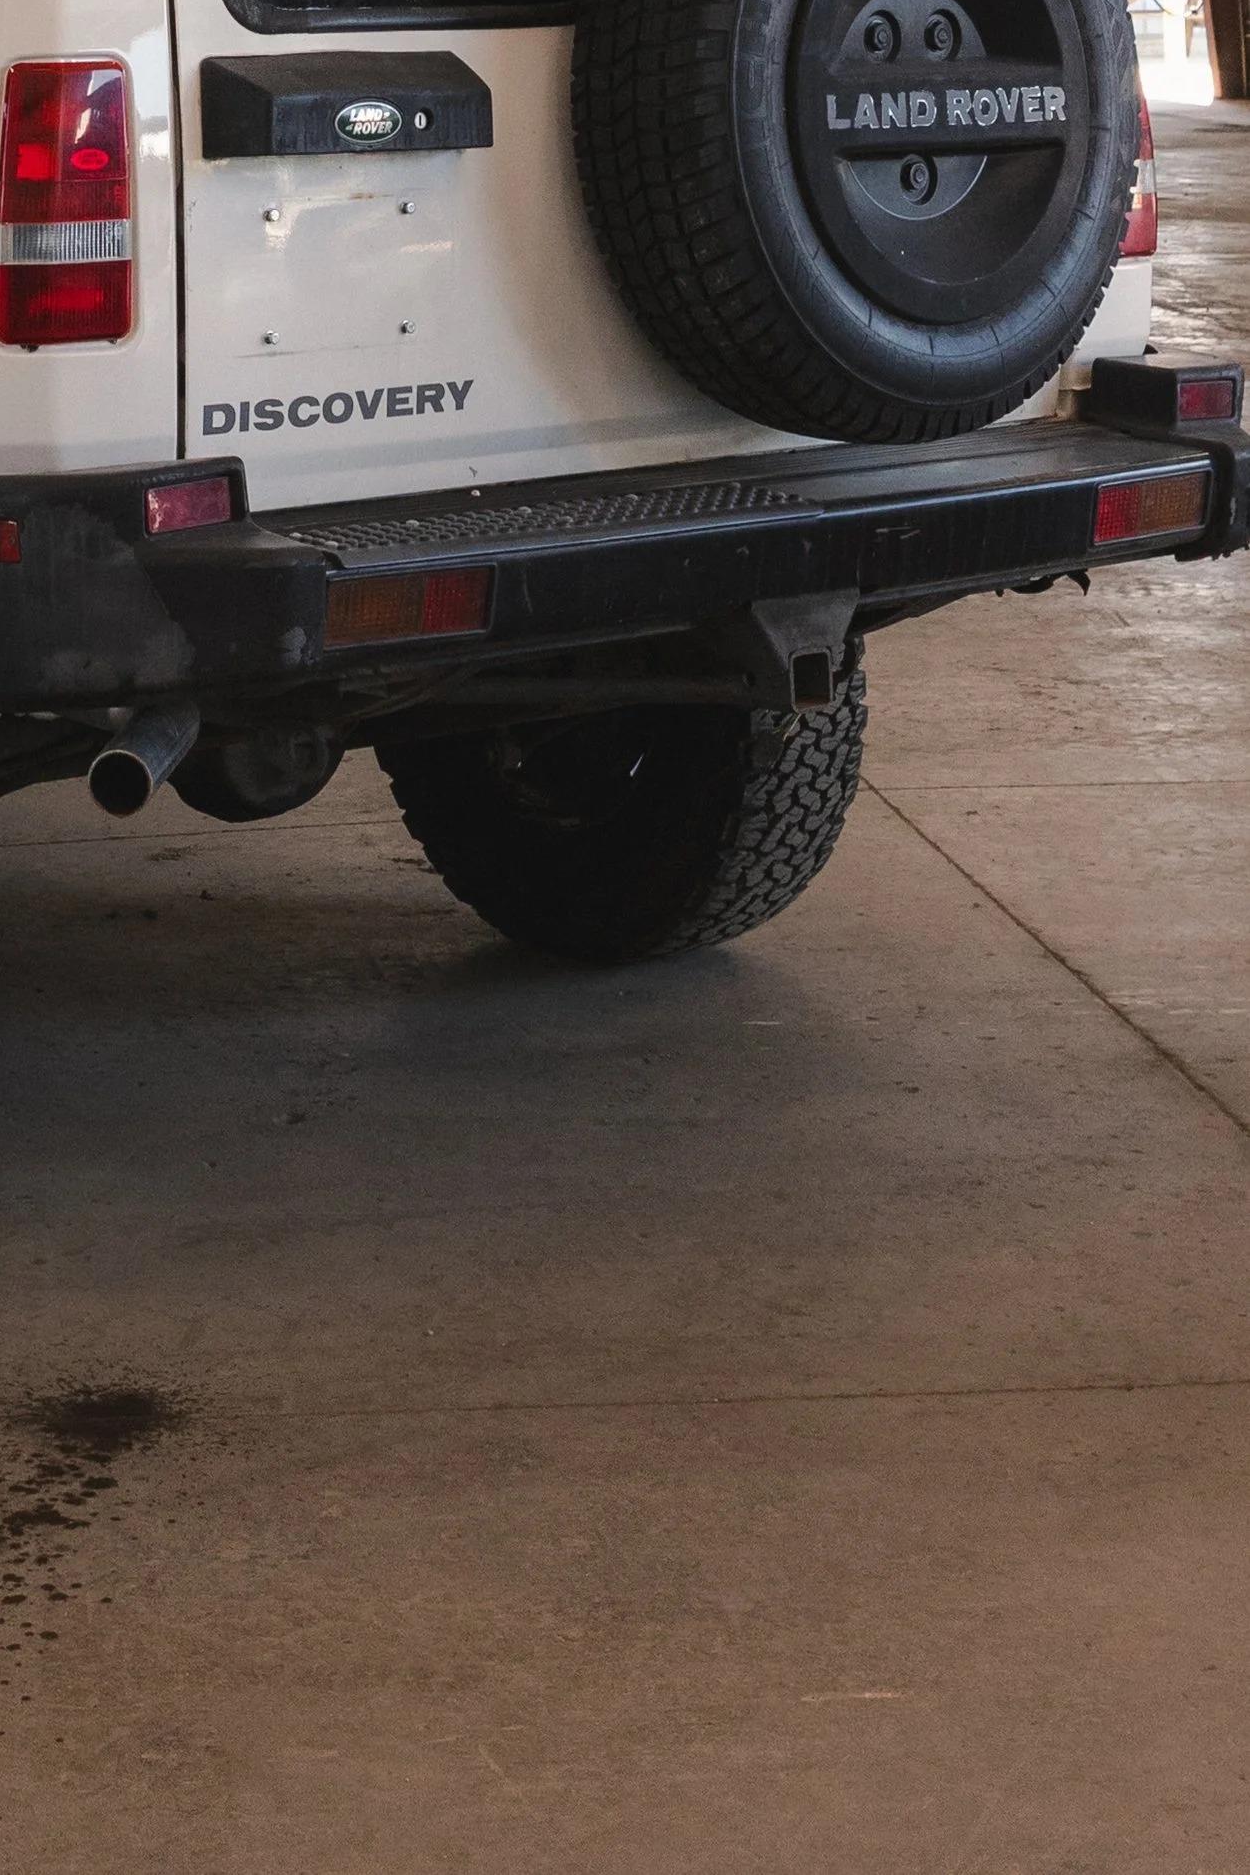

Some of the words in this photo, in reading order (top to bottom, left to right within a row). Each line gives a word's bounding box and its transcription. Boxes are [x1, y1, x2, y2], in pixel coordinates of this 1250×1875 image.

[350, 108, 383, 122] LAND
[826, 90, 937, 130] LAND
[946, 85, 1067, 126] ROVER
[352, 121, 393, 135] ROVER
[202, 379, 474, 436] DISCOVERY
